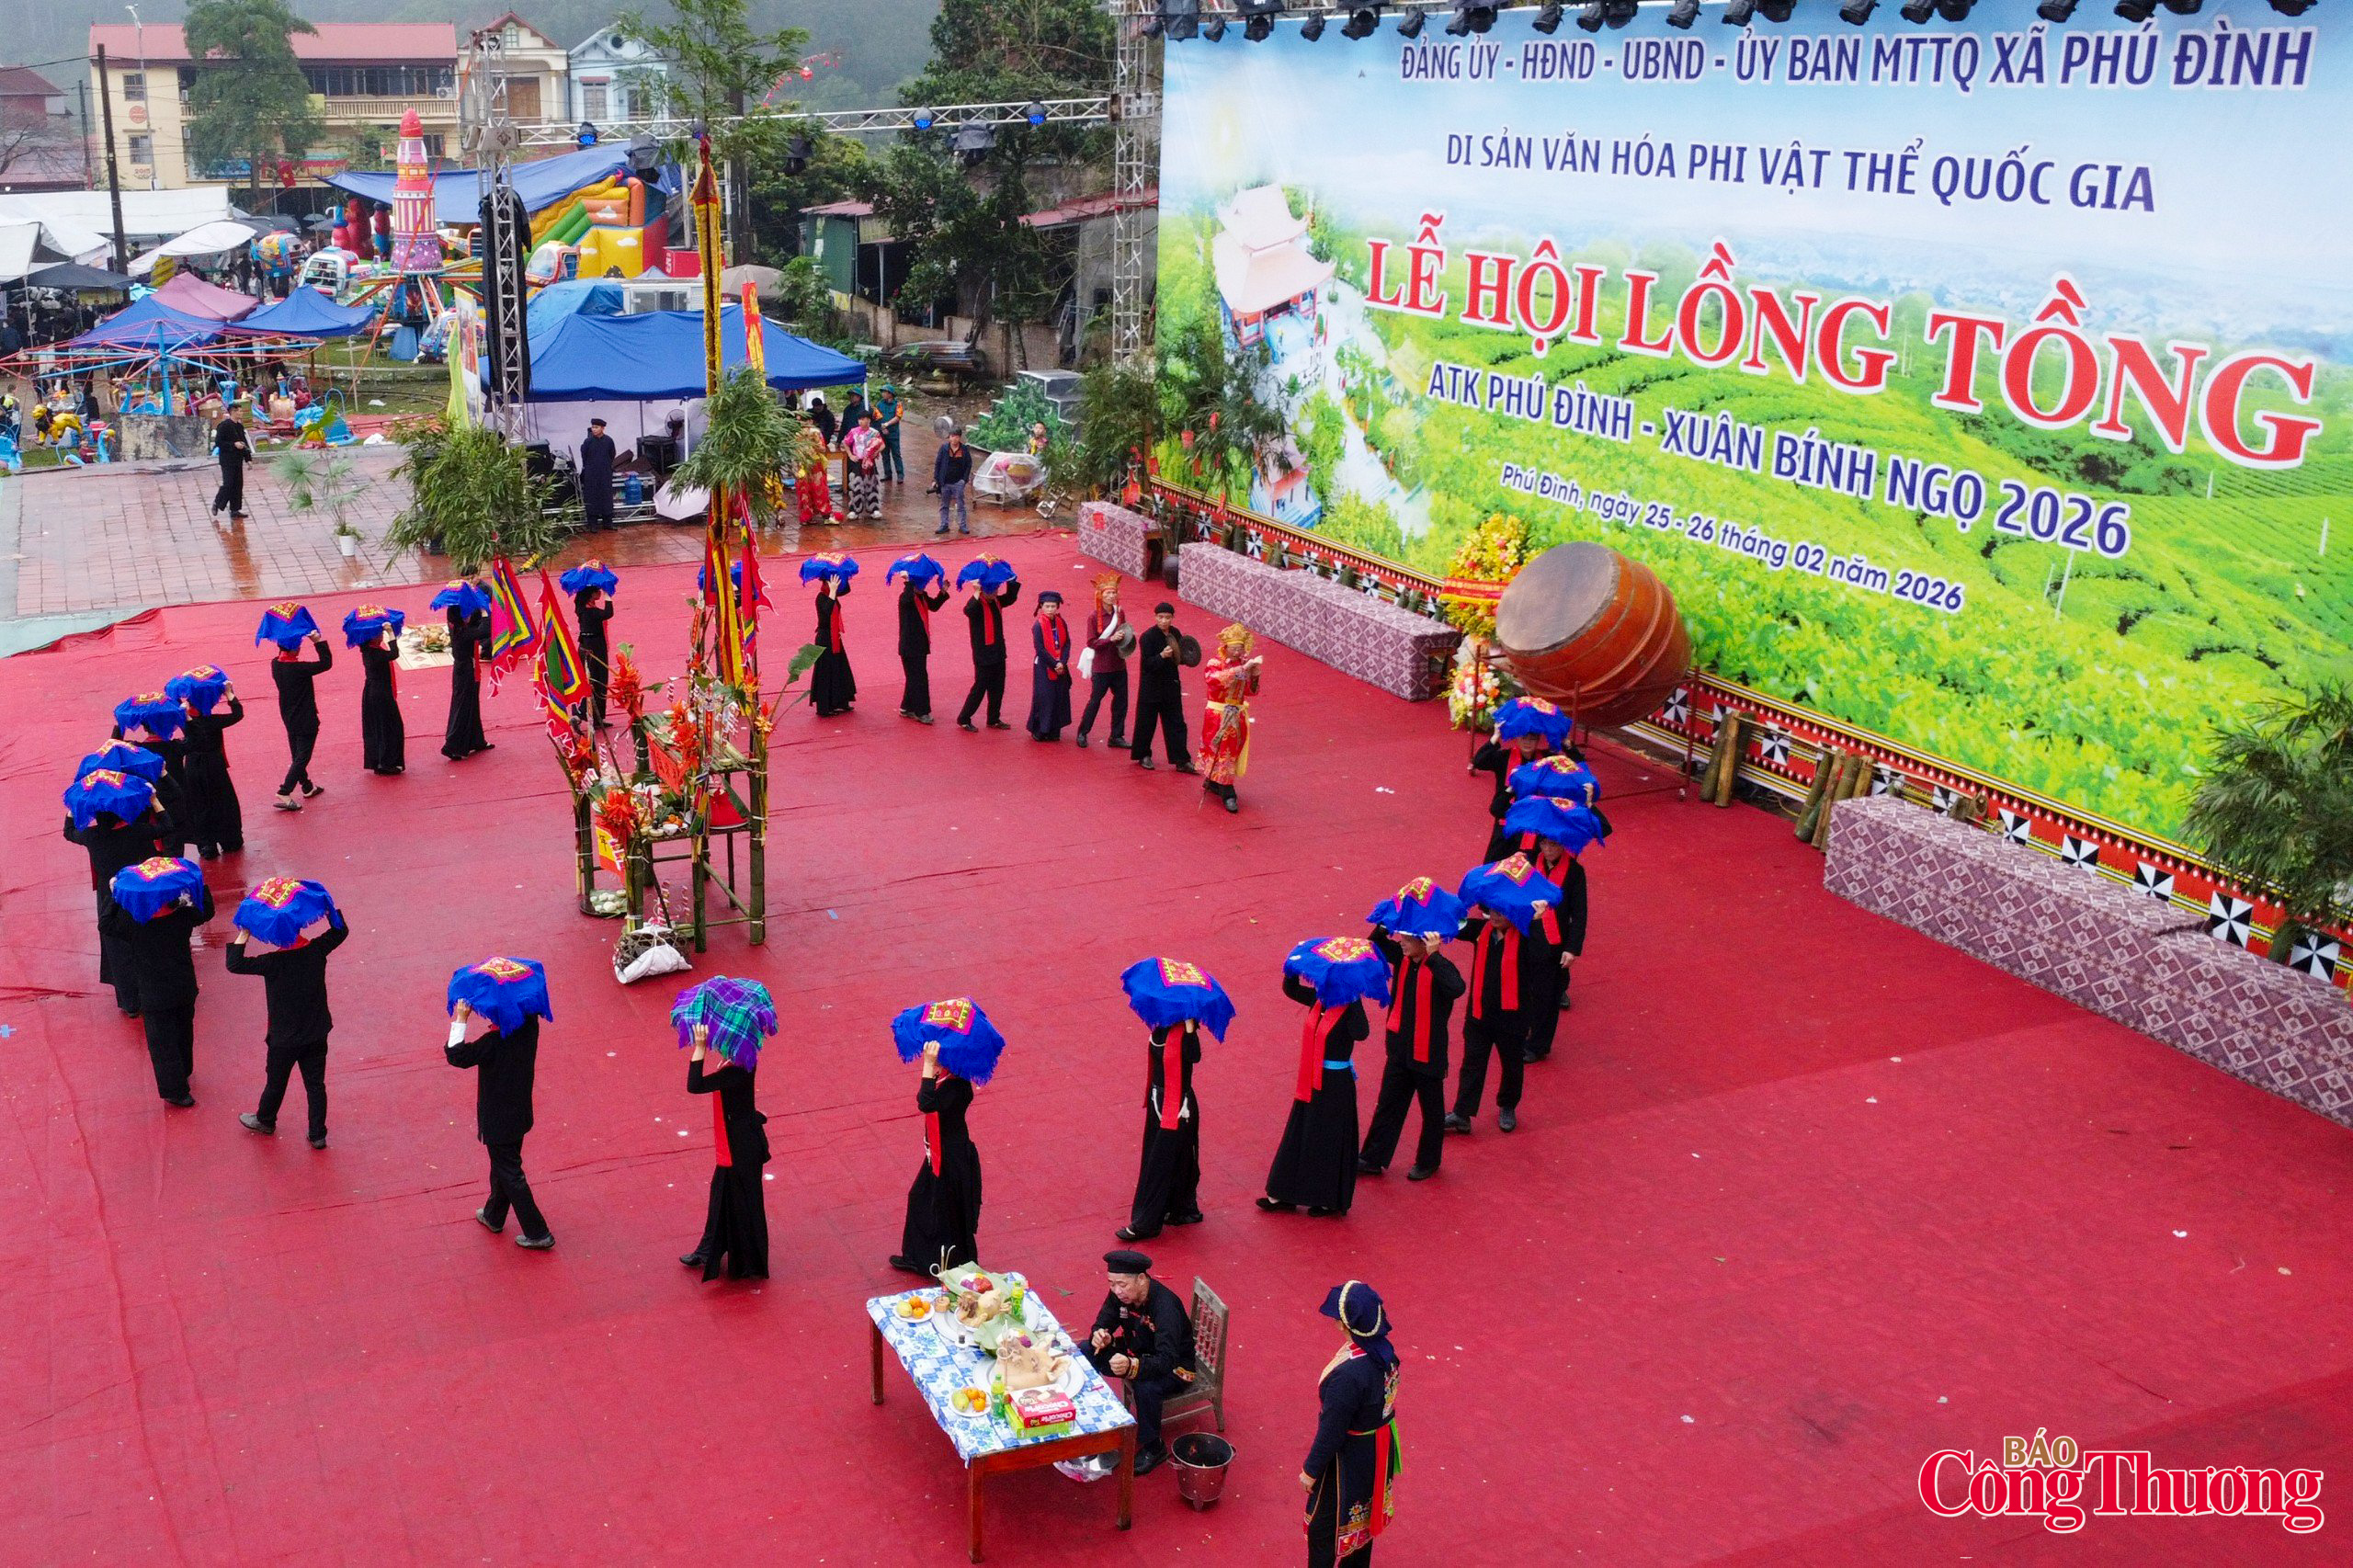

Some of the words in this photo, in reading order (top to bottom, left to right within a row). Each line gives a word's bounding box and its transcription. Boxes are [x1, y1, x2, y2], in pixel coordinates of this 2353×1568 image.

[1401, 36, 1461, 79] ĐẢNG
[1469, 35, 1499, 79] ỦY
[1522, 42, 1595, 79] HĐND
[1624, 40, 1705, 80] UBND
[1735, 28, 1779, 81] ỦY
[1789, 39, 1860, 82] BAN
[1872, 37, 1979, 93] MTTQ
[1990, 27, 2046, 84] XÃ
[2060, 22, 2158, 85] PHÚ
[2174, 20, 2313, 85] ĐÌNH
[1448, 135, 1473, 165] DI
[1481, 127, 1532, 169] SẢN
[1543, 131, 1600, 173] VĂN
[1612, 133, 1676, 178] HÓA
[1688, 145, 1747, 183] PHI
[1760, 141, 1831, 195] VẬT
[1844, 138, 1924, 195] THỂ
[1933, 146, 2055, 207] QUỐC
[2070, 165, 2154, 212] GIA
[1365, 213, 1444, 313] LỄ
[1463, 240, 1603, 351] HỘI
[1620, 242, 1895, 387] LỒNG
[1930, 278, 2320, 461] TỒNG
[1429, 364, 1480, 405] ATK
[1488, 376, 1545, 419] PHÚ
[1553, 389, 1631, 439] ĐÌNH
[1663, 411, 1762, 470] XUÂN
[1774, 429, 1874, 496] BÍNH
[1888, 460, 1983, 530] NGỌ
[1998, 483, 2126, 554] 2026
[1502, 465, 1535, 491] Phú
[1540, 475, 1584, 509] Đình,
[1590, 494, 1641, 523] ngày
[1645, 504, 1671, 528] 25
[1688, 516, 1714, 540] 26
[1721, 524, 1788, 567] tháng
[1794, 544, 1824, 572] 02
[1830, 557, 1888, 590] năm
[1895, 572, 1962, 610] 2026
